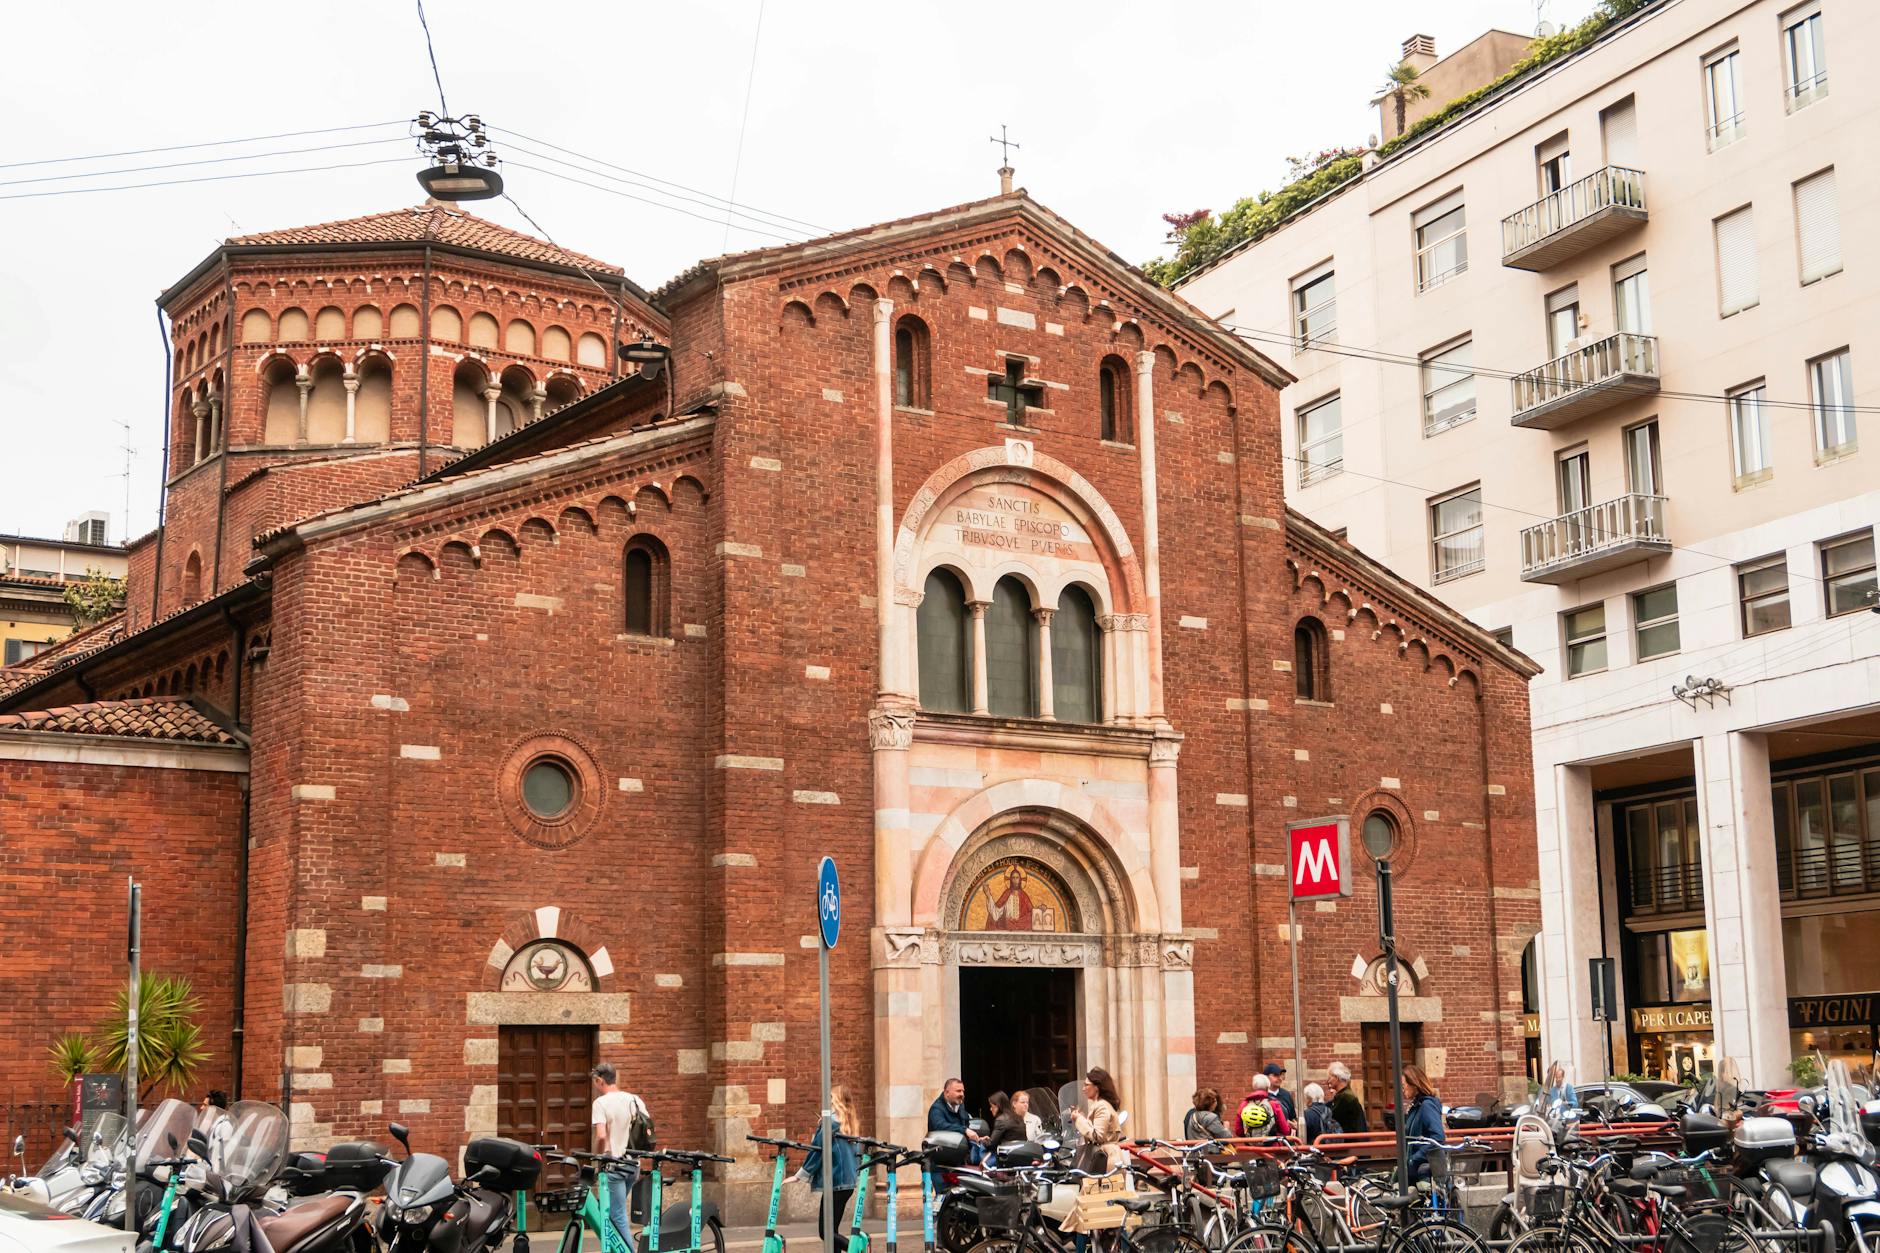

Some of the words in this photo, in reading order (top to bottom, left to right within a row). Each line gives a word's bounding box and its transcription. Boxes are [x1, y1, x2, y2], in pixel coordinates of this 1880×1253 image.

[988, 497, 1040, 514] SANCTIS
[957, 510, 1007, 529] BABYLAE
[1014, 518, 1070, 537] EPISCOPO
[954, 528, 1021, 550] TRIBVSQVE
[1295, 838, 1339, 885] M
[1641, 1013, 1666, 1027] PER
[1668, 1012, 1673, 1026] I
[1794, 998, 1872, 1024] FIGINI
[1527, 1018, 1540, 1032] M
[769, 1197, 778, 1227] TIER
[854, 1196, 864, 1226] TIER
